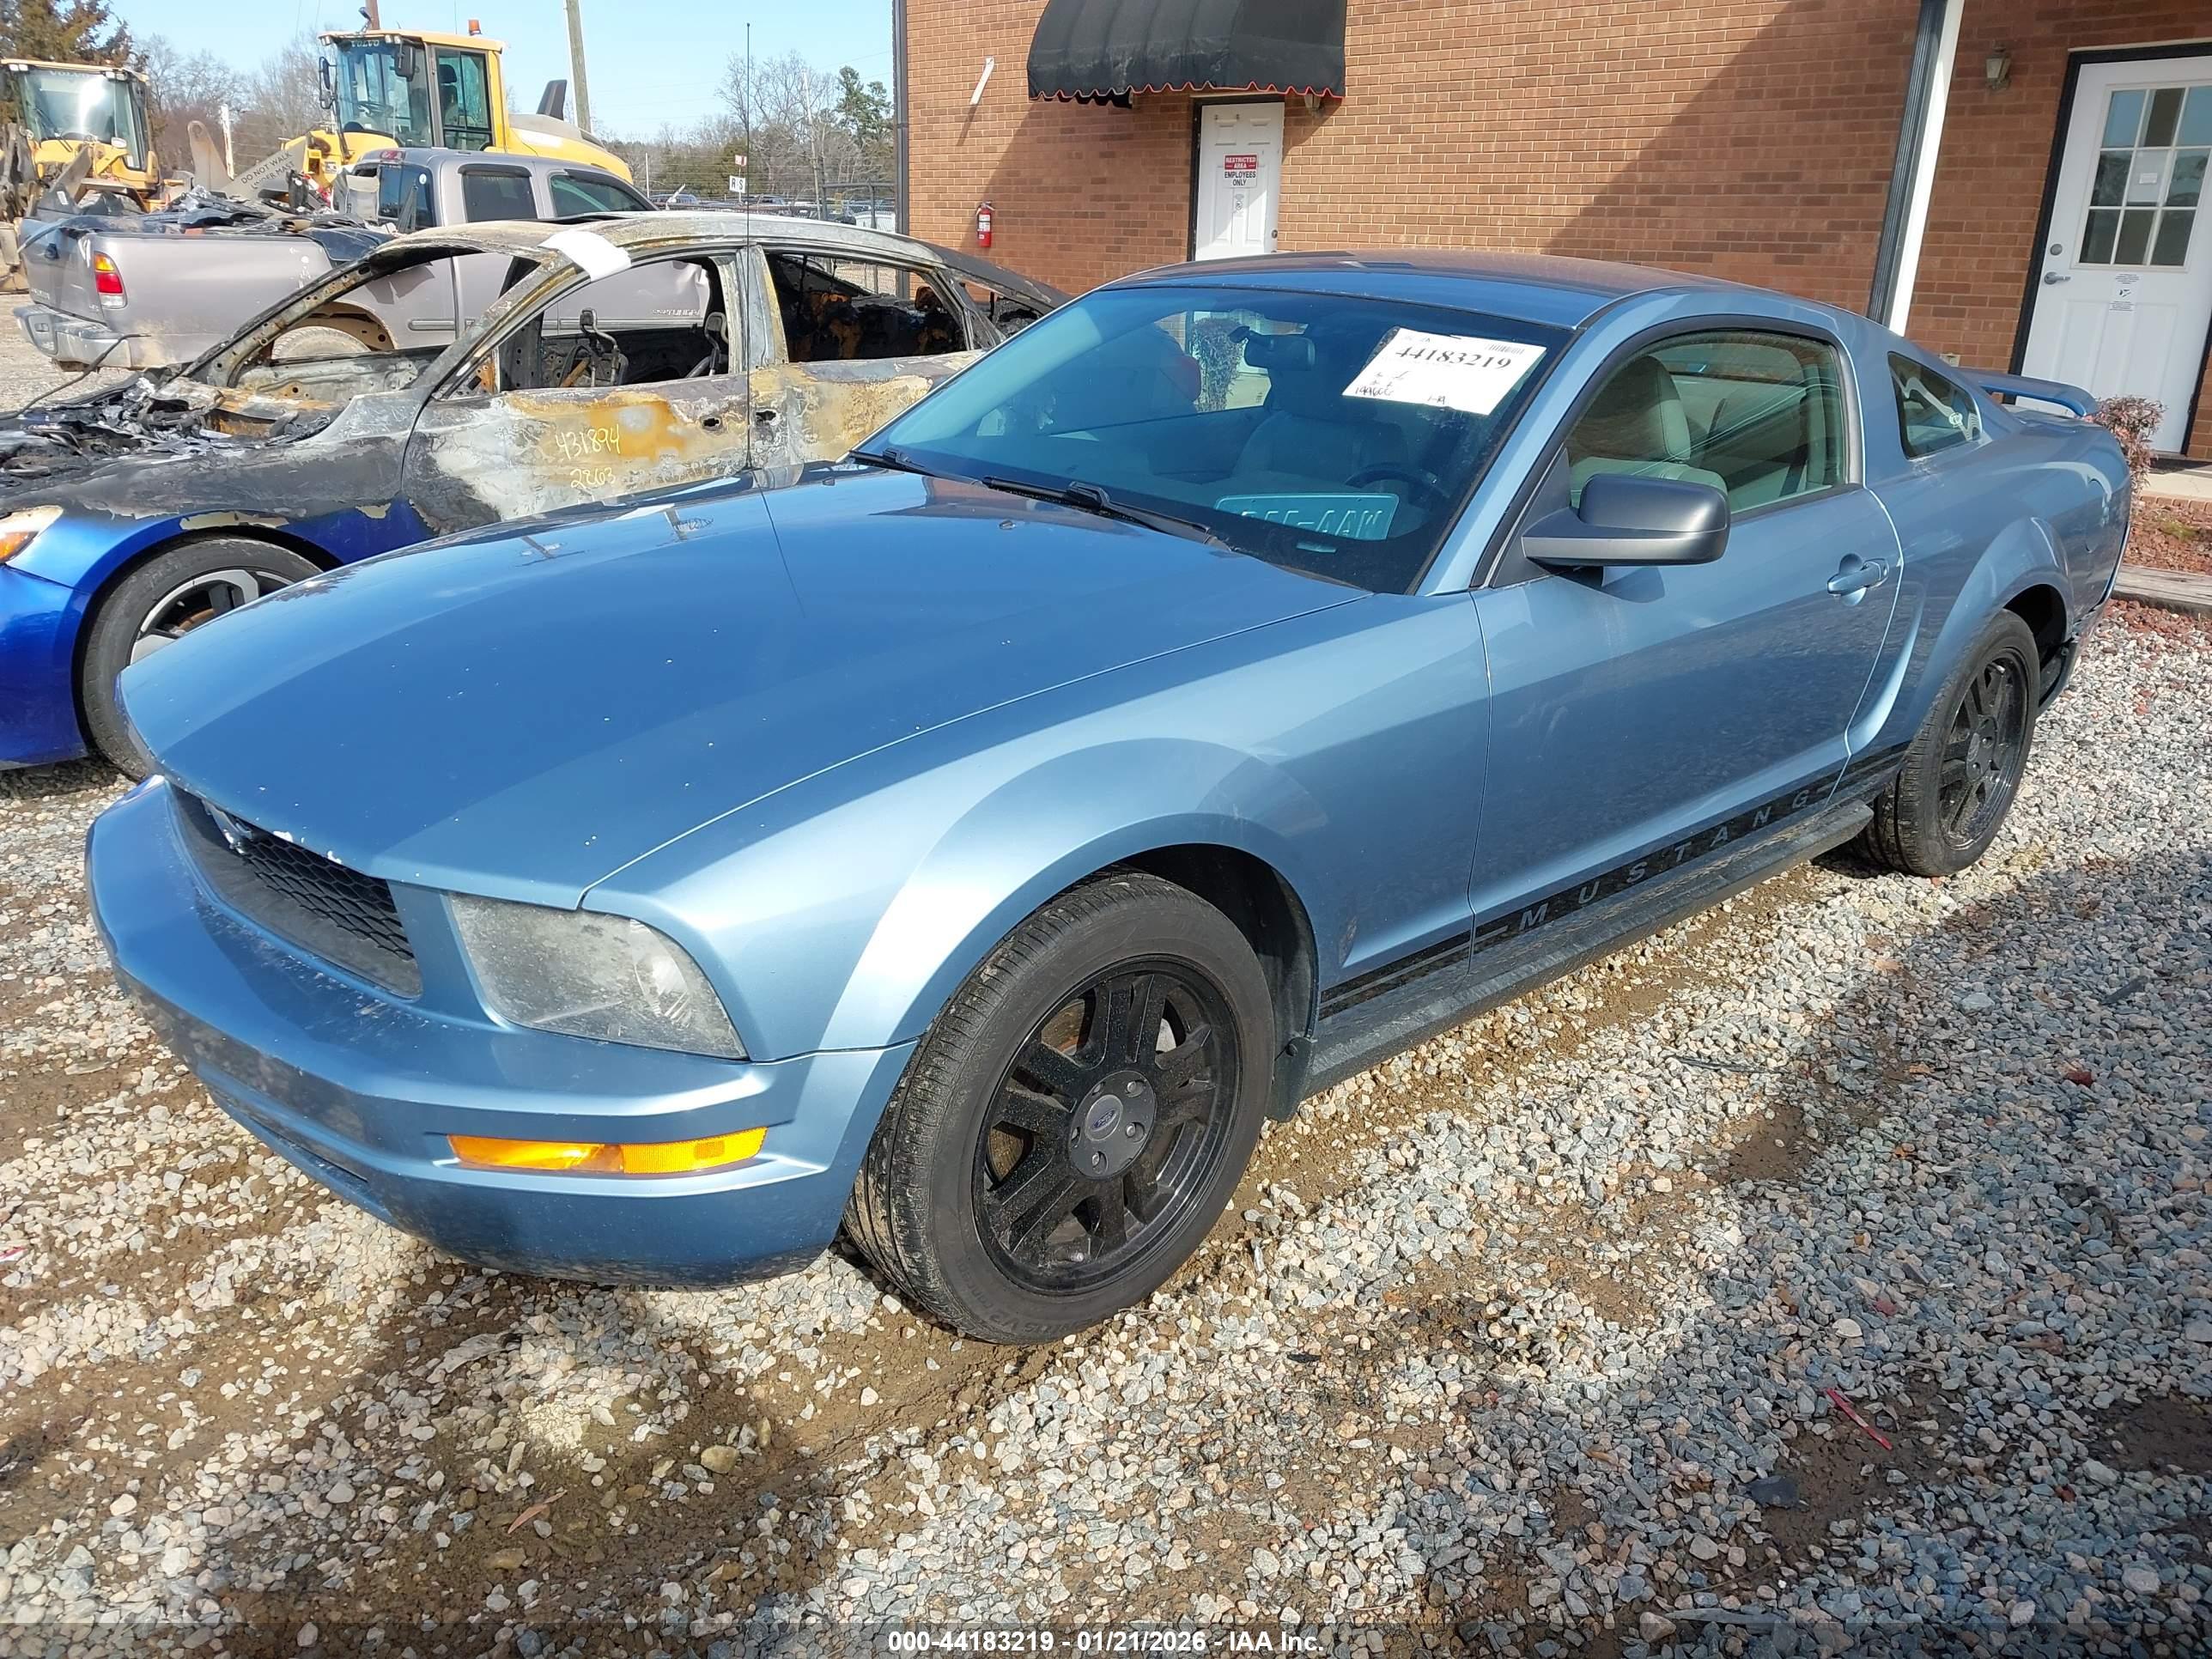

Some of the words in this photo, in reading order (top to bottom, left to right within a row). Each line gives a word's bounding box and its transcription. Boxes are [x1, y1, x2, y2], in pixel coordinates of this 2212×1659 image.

[240, 173, 252, 185] DO
[252, 162, 270, 176] NOT
[271, 151, 293, 167] WALK
[275, 161, 295, 177] MAST
[1395, 346, 1511, 369] 44183219
[555, 423, 621, 460] 431894
[1519, 789, 1809, 932] MUSTANG
